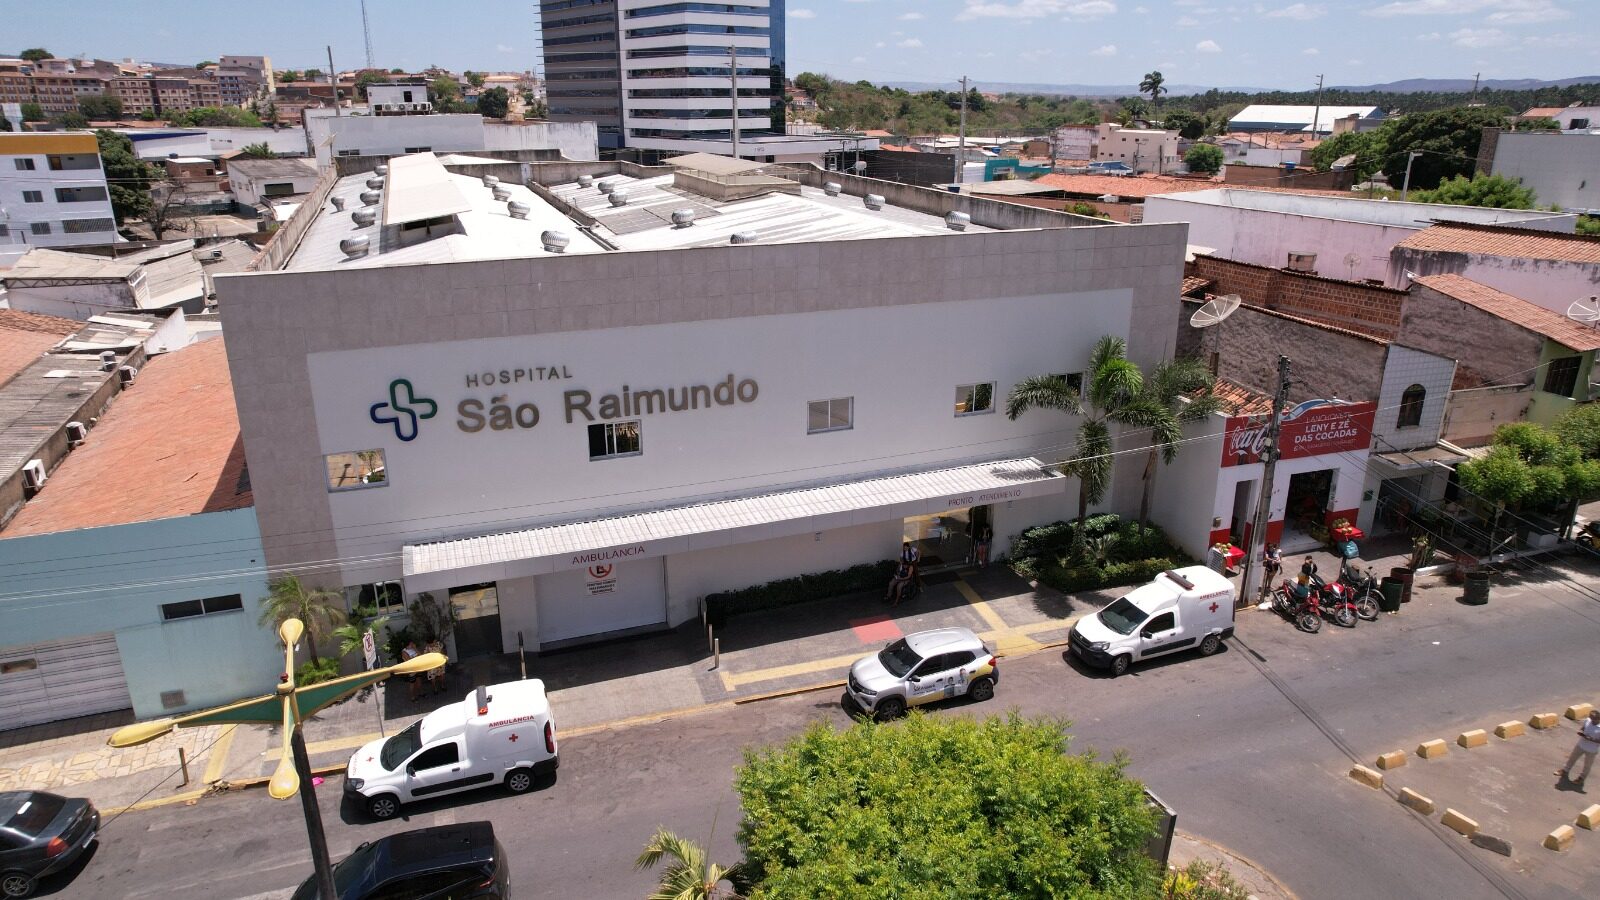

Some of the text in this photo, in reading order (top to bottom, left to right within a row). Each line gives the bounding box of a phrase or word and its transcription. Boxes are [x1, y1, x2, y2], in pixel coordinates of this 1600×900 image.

[466, 365, 573, 388] HOSPITAL
[456, 373, 760, 434] São Raimundo
[1305, 423, 1329, 433] LENY
[1330, 421, 1337, 431] E
[1294, 428, 1358, 444] DAS COCADAS
[948, 496, 974, 507] PRONTO
[572, 545, 646, 565] AMBULANCIA
[488, 715, 535, 728] AMBULANCIA
